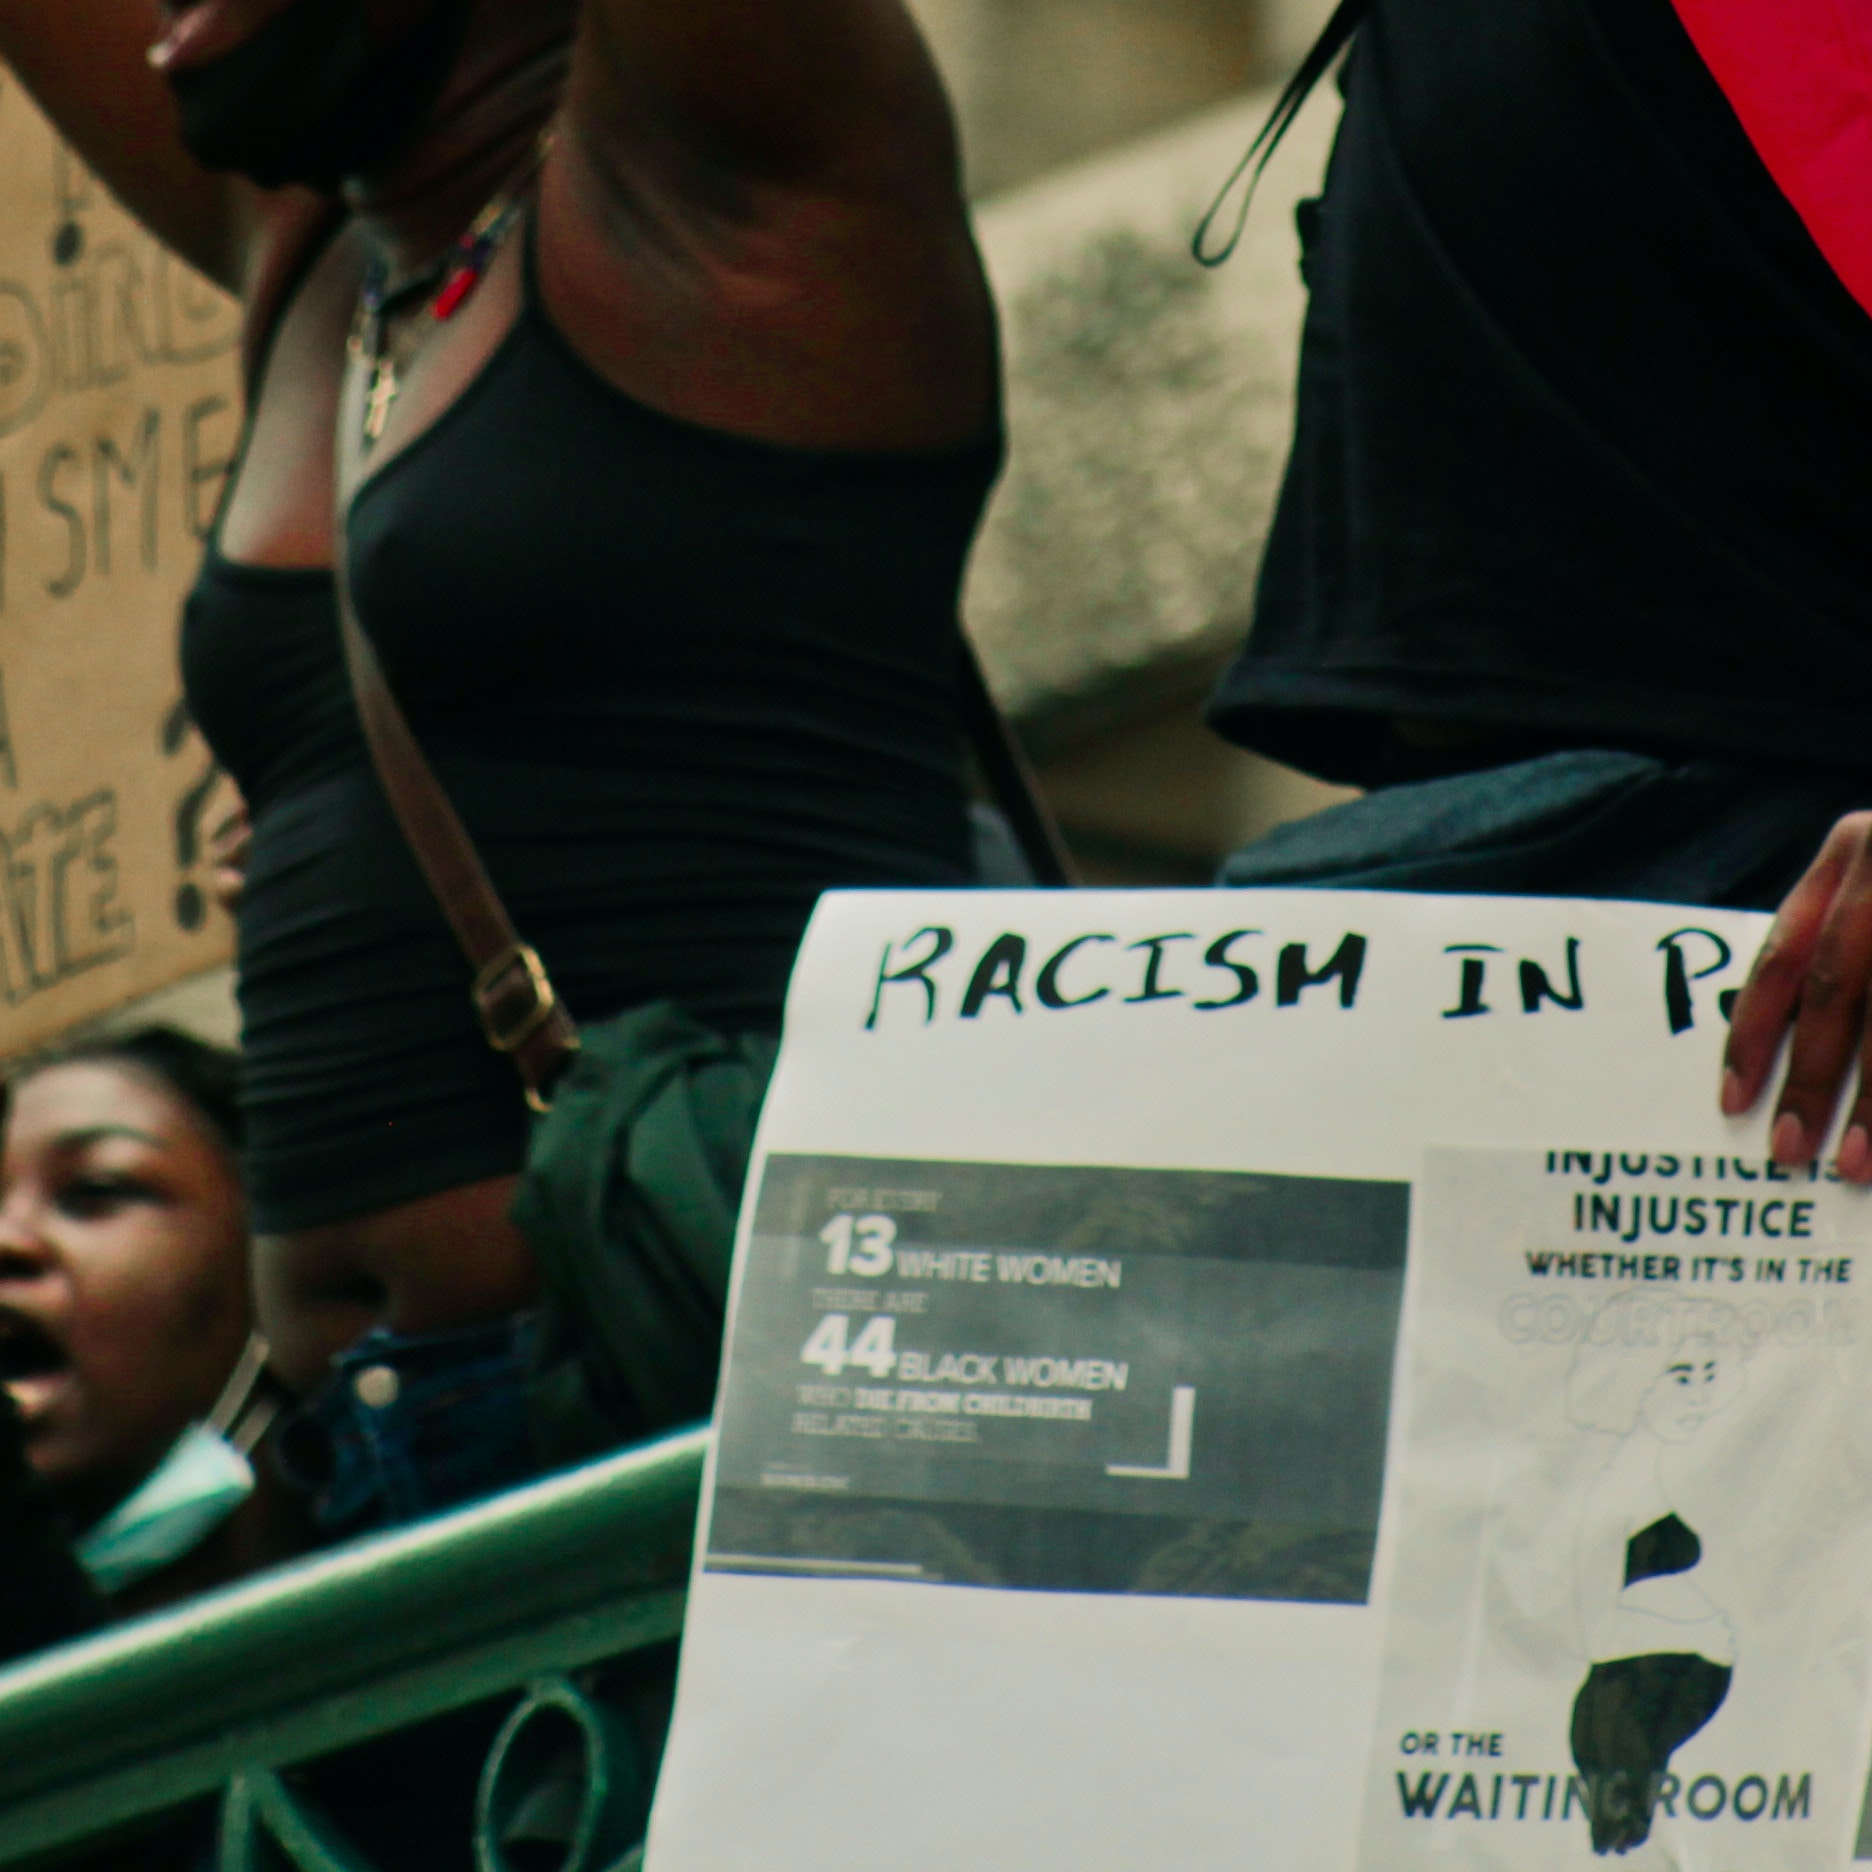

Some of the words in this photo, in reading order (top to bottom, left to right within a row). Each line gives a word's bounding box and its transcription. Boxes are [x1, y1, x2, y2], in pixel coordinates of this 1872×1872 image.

[864, 926, 1369, 1031] RACISM
[1441, 936, 1584, 1020] IN
[1573, 1192, 1816, 1243] INJUSTICE
[819, 1212, 898, 1277] 13
[896, 1249, 992, 1282] WHITE
[995, 1253, 1122, 1289] WOMEN
[1525, 1250, 1681, 1282] WHETHER
[1692, 1256, 1744, 1283] IT'S
[1755, 1258, 1785, 1283] IN
[1799, 1258, 1853, 1284] THE
[801, 1313, 897, 1378] 44
[897, 1351, 998, 1386] BLACK
[1003, 1355, 1129, 1391] WOMEN
[1399, 1731, 1439, 1756] OR
[1450, 1732, 1504, 1758] THE
[1396, 1768, 1629, 1822] WAITING
[1649, 1768, 1814, 1822] ROOM
